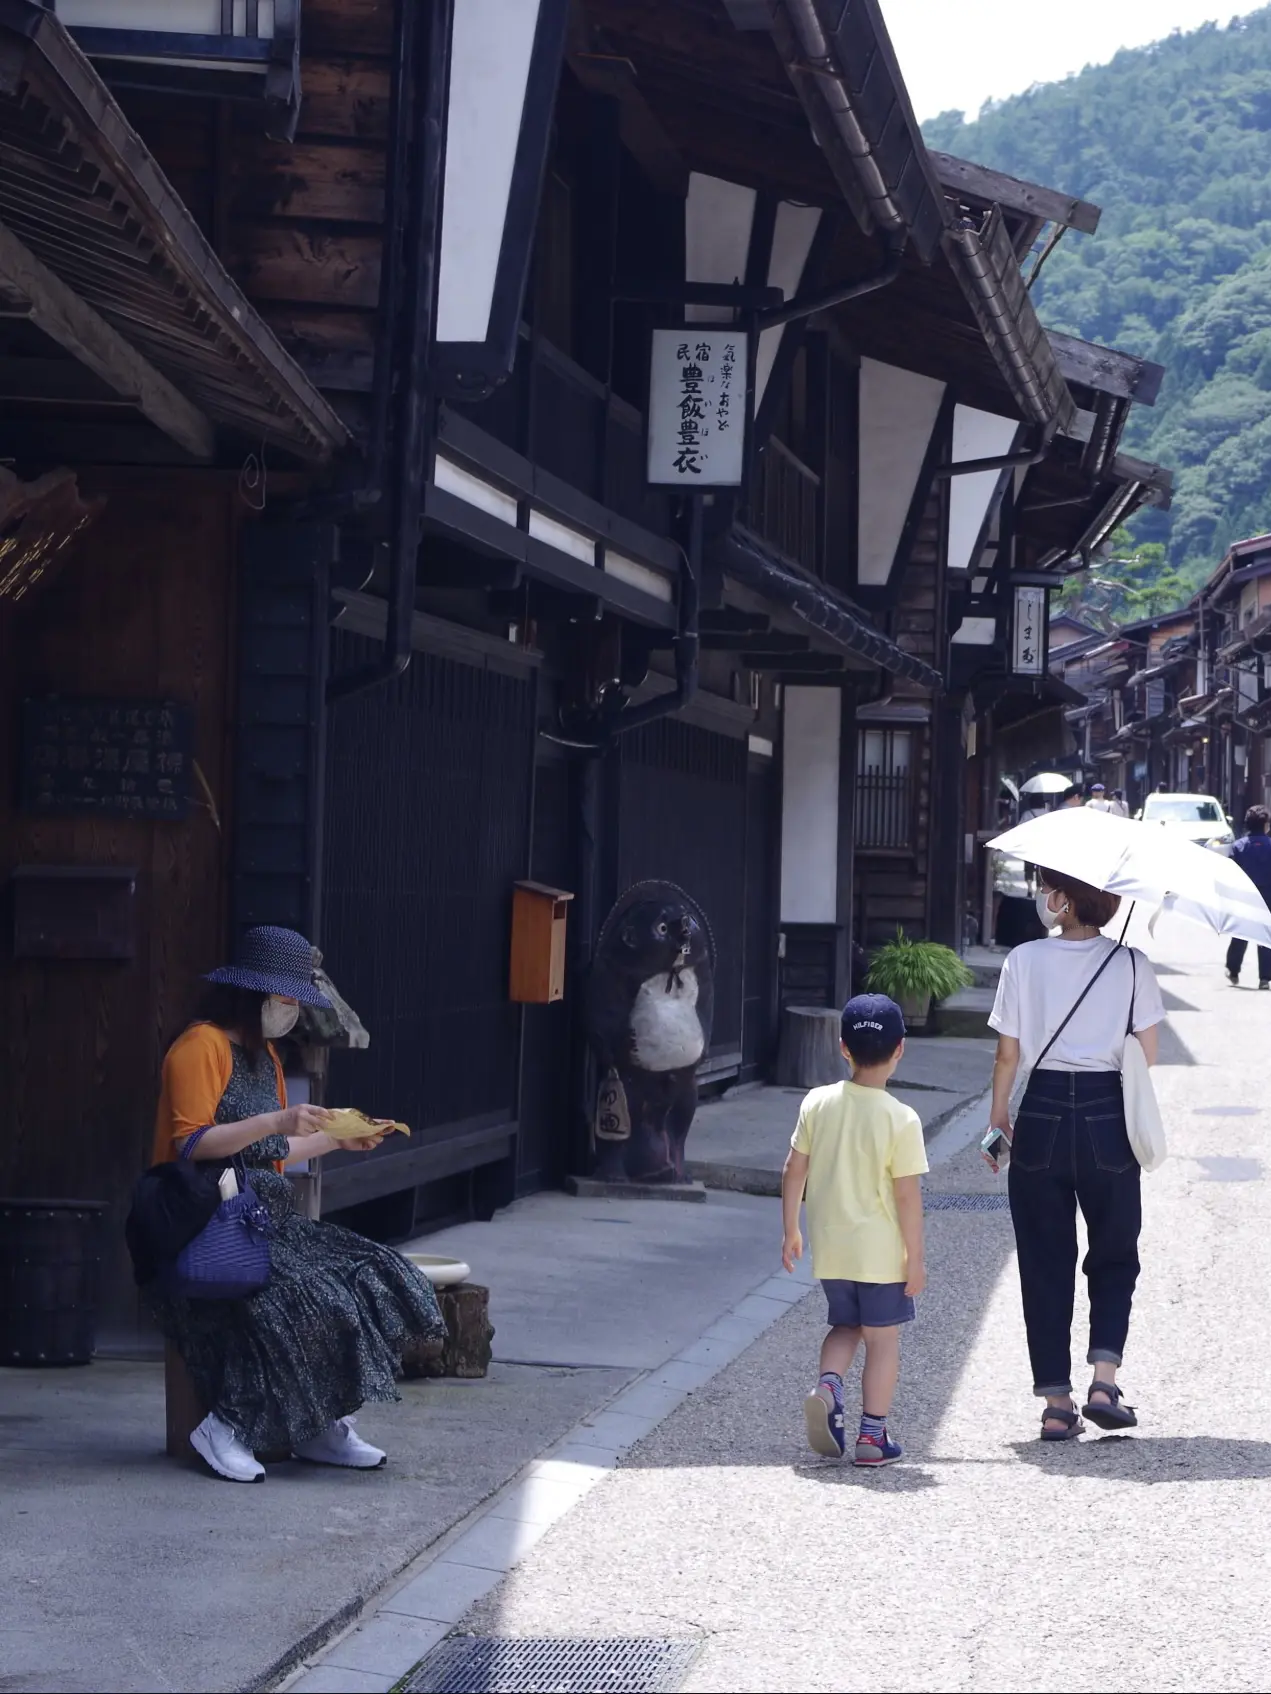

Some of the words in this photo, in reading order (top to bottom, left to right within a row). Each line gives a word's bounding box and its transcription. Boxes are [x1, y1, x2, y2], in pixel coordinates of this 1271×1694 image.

[676, 342, 712, 362] 民宿
[715, 343, 736, 432] 気楽なおやど
[672, 362, 706, 474] 豊飯豊衣
[852, 1021, 883, 1031] HILFIGER
